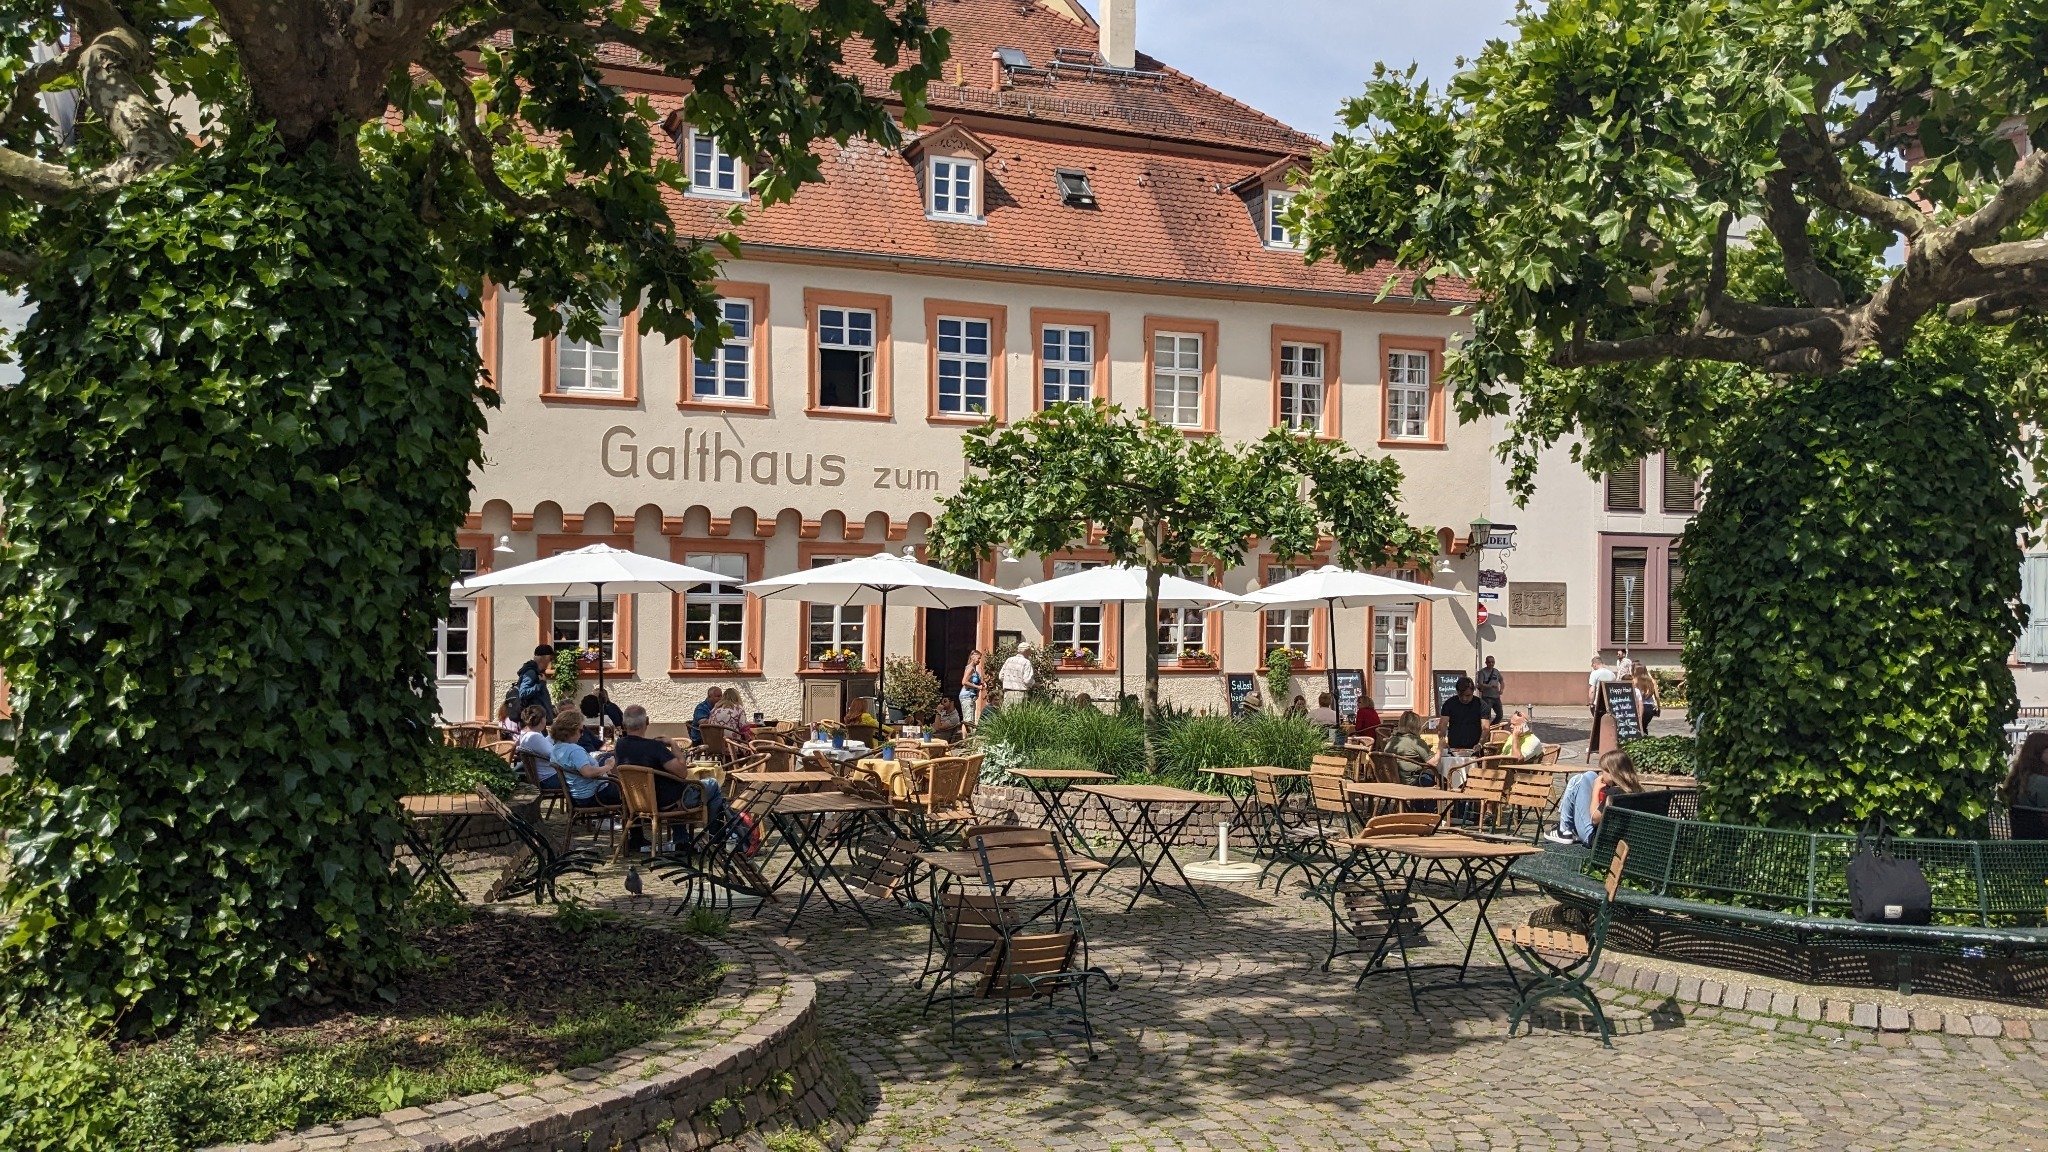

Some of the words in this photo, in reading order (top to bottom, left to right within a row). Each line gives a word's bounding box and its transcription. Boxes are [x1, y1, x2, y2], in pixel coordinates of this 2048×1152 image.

[873, 466, 939, 490] zum
[1489, 536, 1509, 545] DEL
[1231, 680, 1253, 690] Selbst
[1230, 692, 1243, 702] bed
